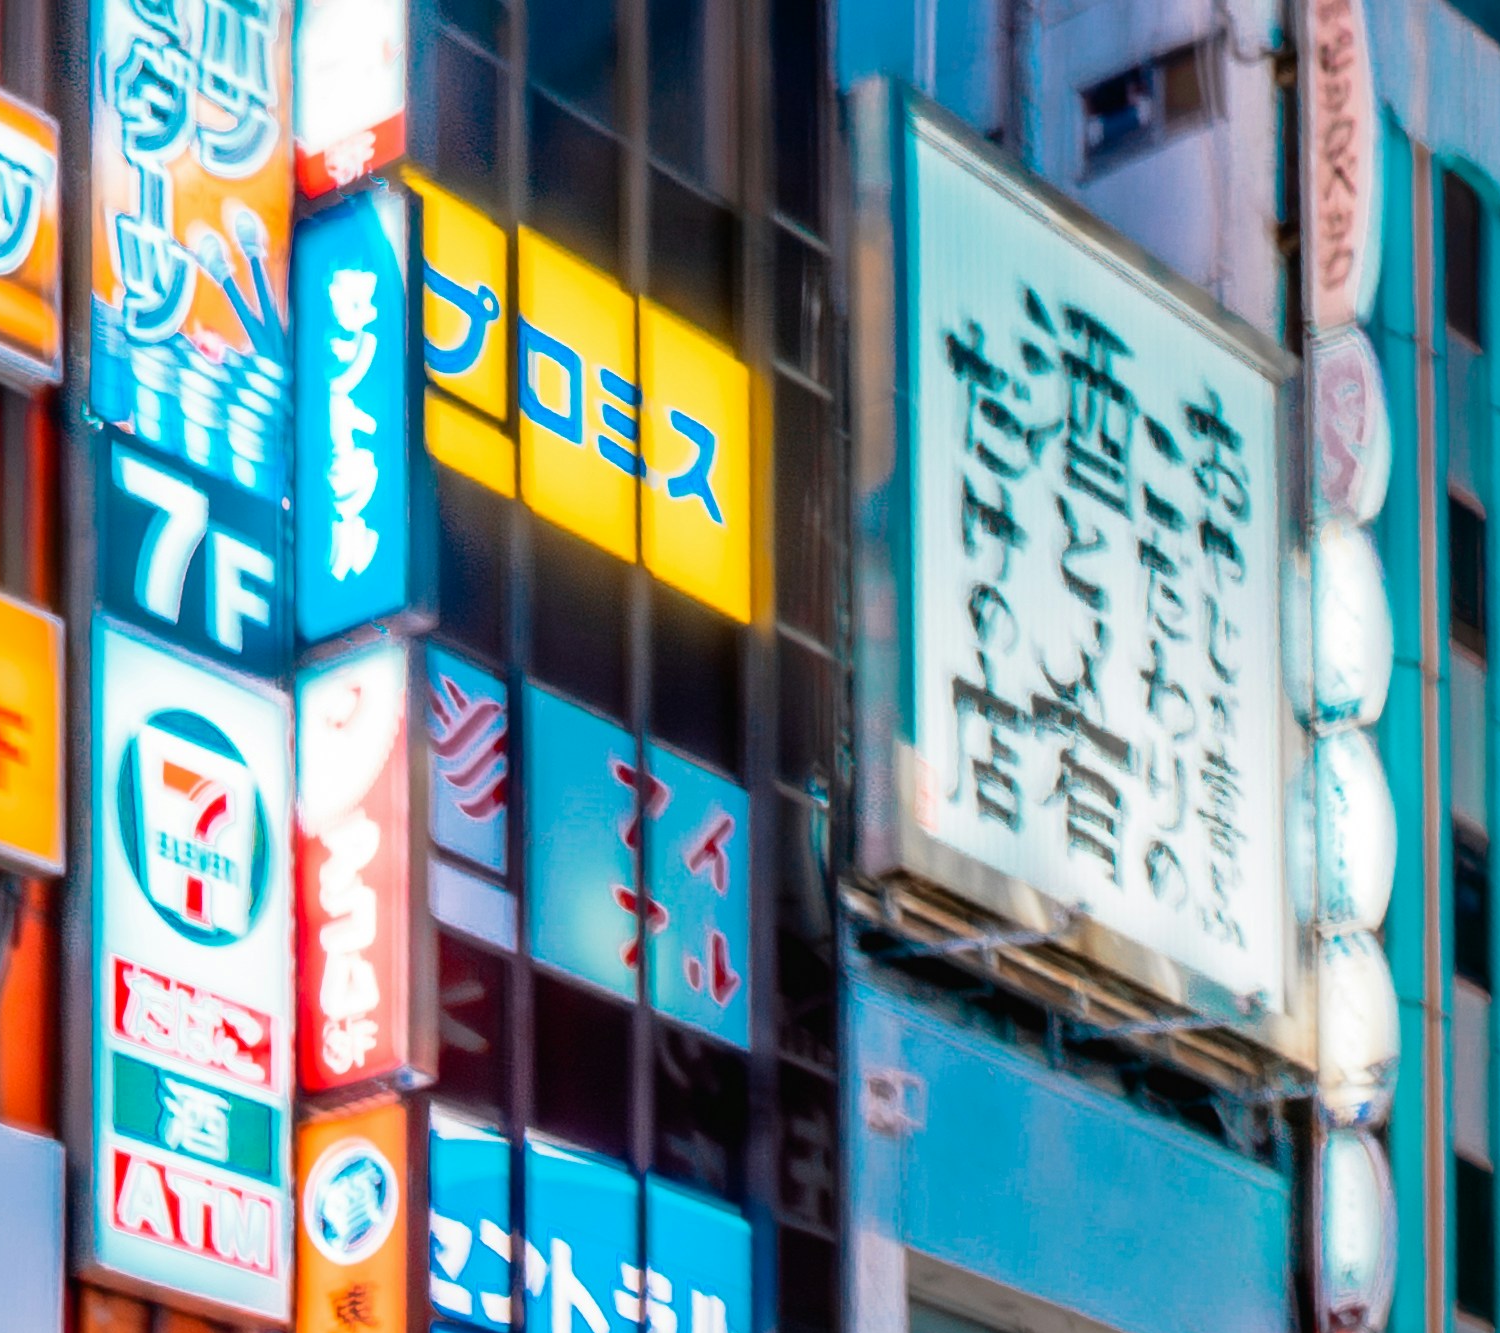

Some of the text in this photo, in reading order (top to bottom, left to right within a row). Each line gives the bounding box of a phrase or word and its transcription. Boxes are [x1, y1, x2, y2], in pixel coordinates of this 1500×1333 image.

[328, 268, 379, 581] セントラル
[424, 262, 726, 528] プロミス
[110, 448, 275, 655] 7F
[125, 975, 267, 1083] たばこ
[162, 1075, 232, 1163] 酒
[120, 1160, 271, 1270] ATM
